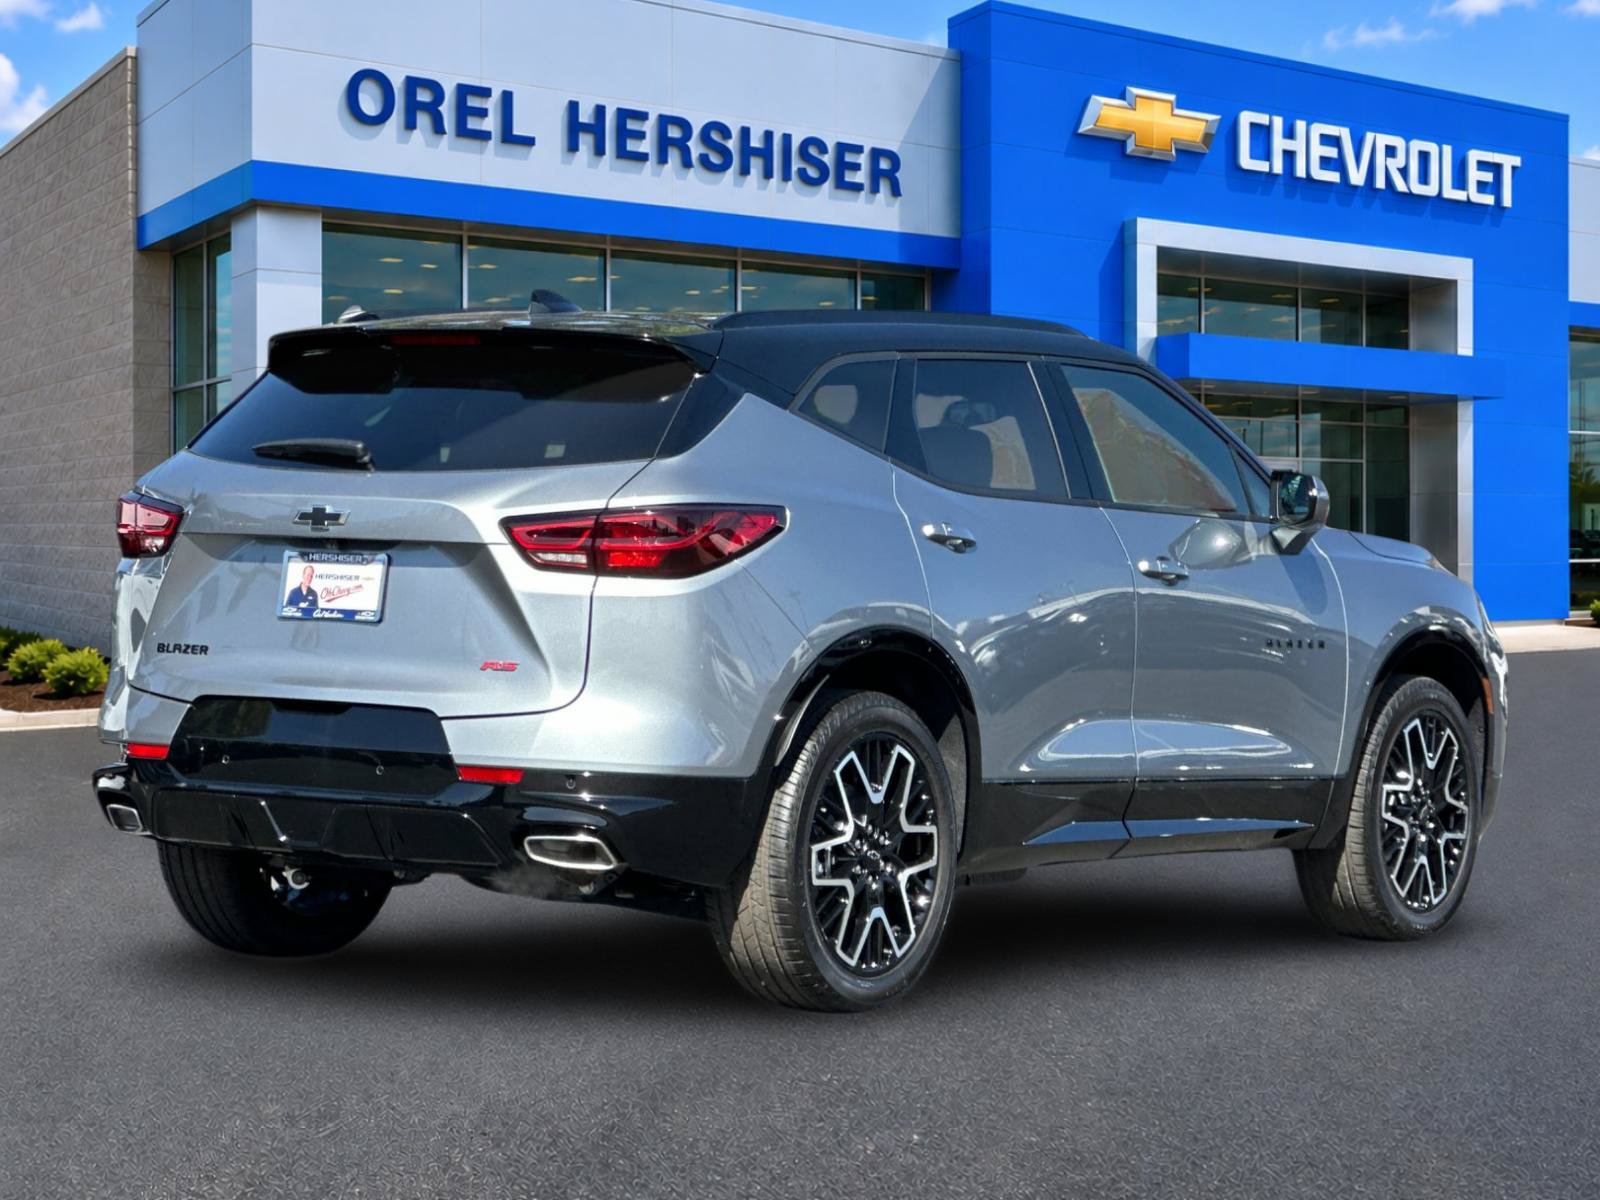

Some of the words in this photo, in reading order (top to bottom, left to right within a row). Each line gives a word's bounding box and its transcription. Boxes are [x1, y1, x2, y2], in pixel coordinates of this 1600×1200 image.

[348, 68, 535, 147] OREL
[568, 100, 903, 198] HERSHISER
[1237, 110, 1521, 208] CHEVROLET
[309, 553, 362, 562] HERSHISER
[157, 643, 209, 656] BLAZER
